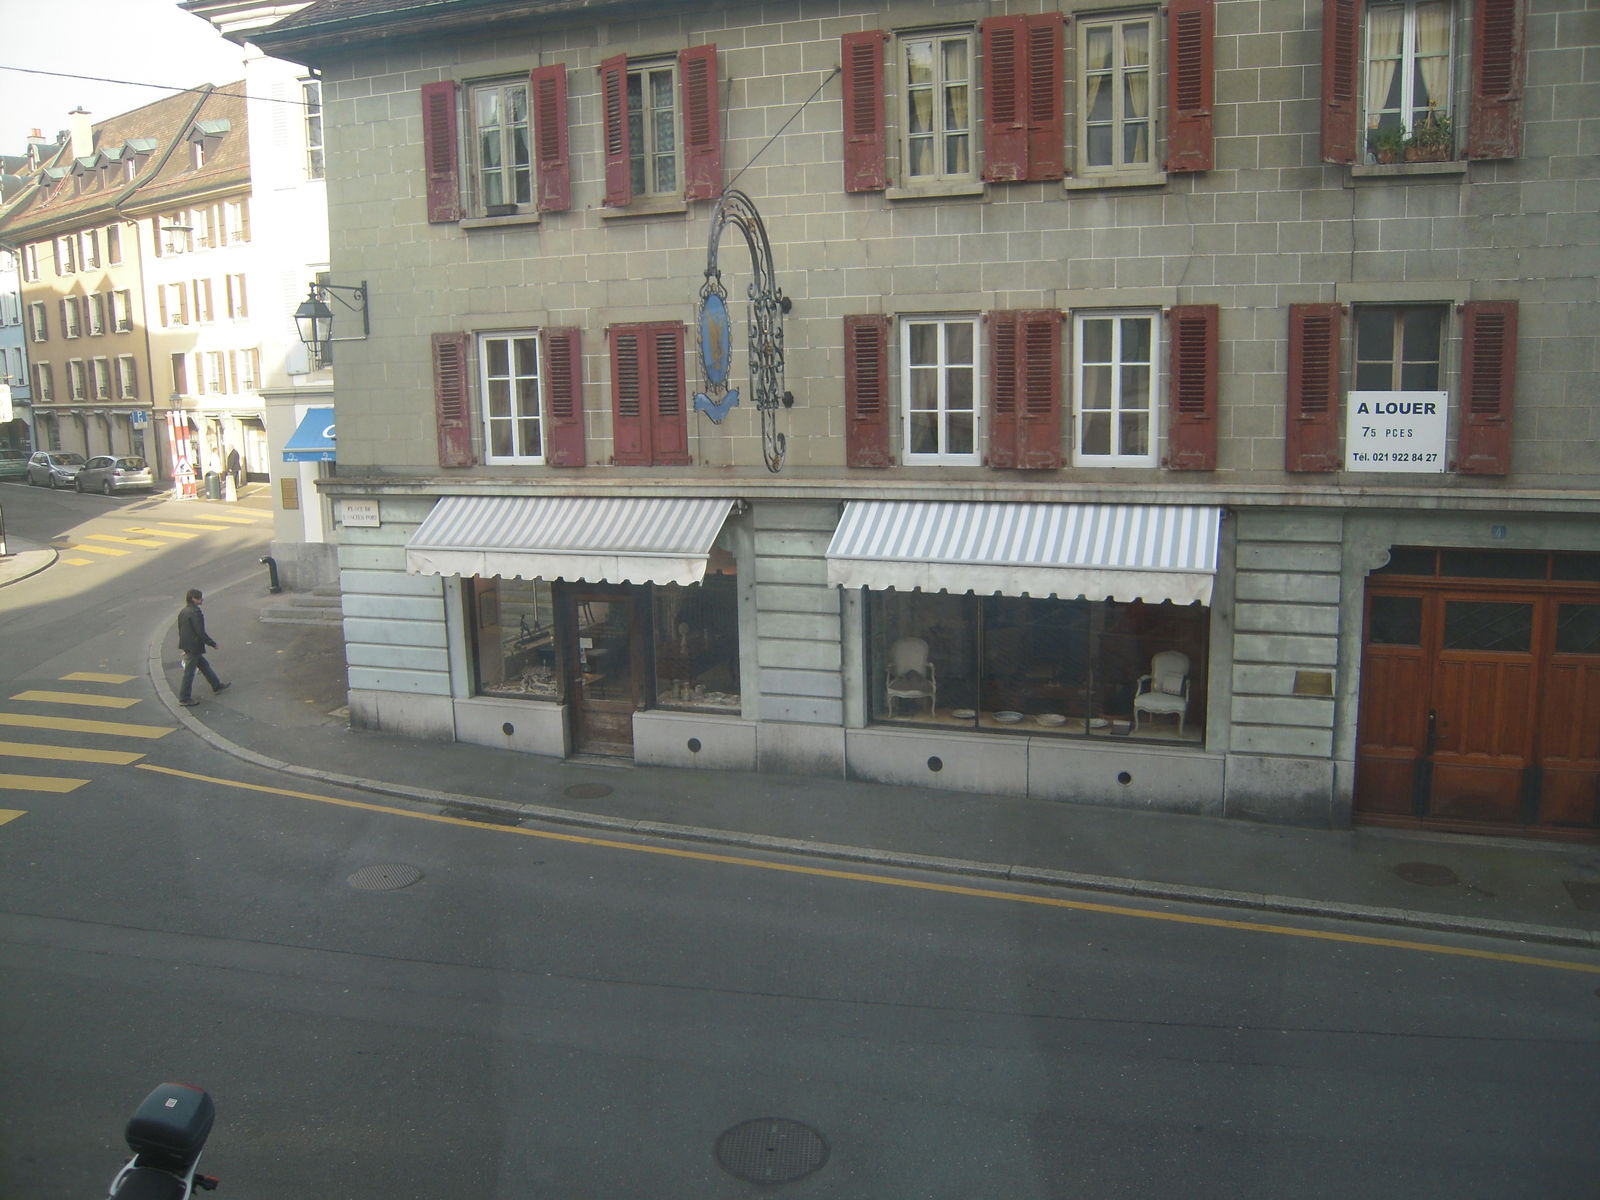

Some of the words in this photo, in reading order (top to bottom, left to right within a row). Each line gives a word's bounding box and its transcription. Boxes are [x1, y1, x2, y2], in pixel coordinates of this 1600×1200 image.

[1357, 402, 1369, 414] A
[1375, 402, 1436, 414] LOUER
[1385, 428, 1413, 437] PCES
[1353, 452, 1369, 461] Tél.
[1372, 453, 1389, 461] 021
[1392, 453, 1409, 462] 922
[1412, 453, 1423, 462] 84
[1426, 453, 1438, 462] 27
